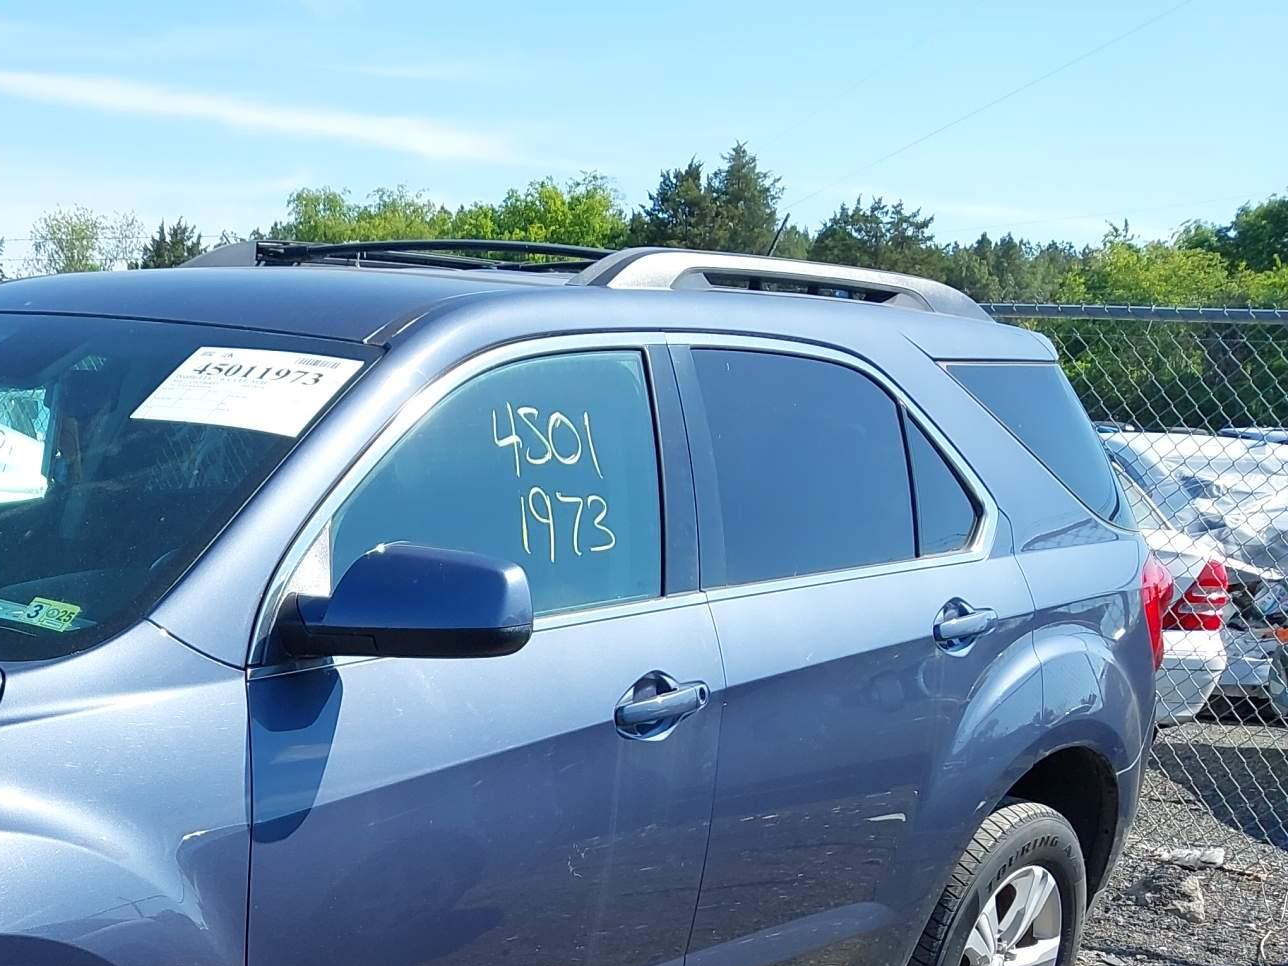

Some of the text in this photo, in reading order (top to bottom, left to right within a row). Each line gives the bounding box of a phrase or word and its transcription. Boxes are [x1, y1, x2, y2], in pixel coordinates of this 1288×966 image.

[193, 361, 324, 387] 45011973
[492, 401, 604, 480] 4501
[520, 486, 616, 564] 1973
[27, 604, 75, 623] 3 25
[985, 834, 1060, 893] TOURING
